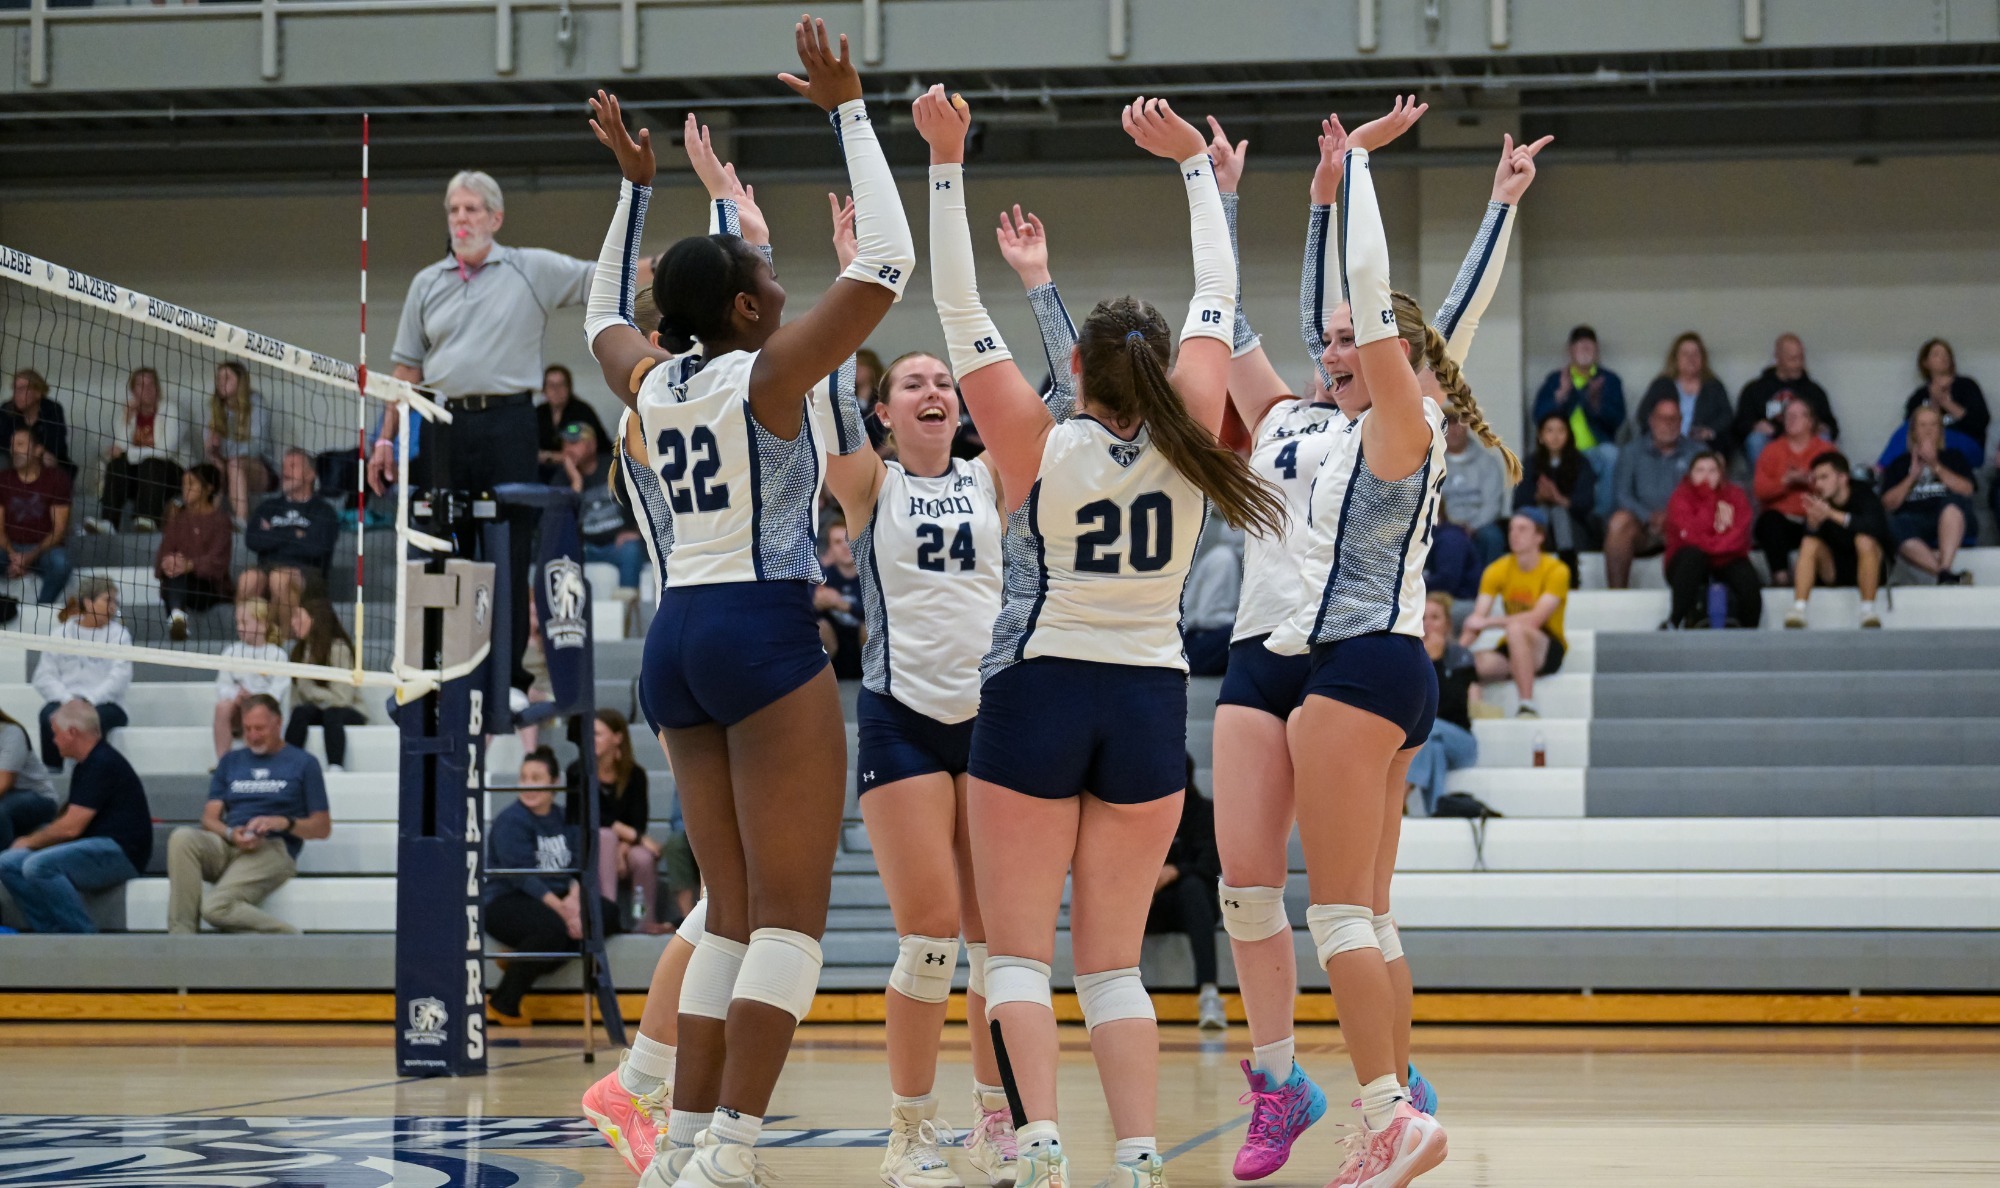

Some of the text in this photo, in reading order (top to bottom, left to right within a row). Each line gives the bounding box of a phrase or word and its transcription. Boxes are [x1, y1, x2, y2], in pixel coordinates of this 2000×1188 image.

[0, 247, 32, 276] LEGE
[67, 269, 117, 304] BLAZERS
[148, 298, 176, 323] HOOD
[176, 308, 218, 338] COLLEGE
[244, 332, 285, 360] BLAZERS
[656, 424, 731, 515] 22
[1274, 440, 1300, 480] 4
[909, 495, 974, 518] HOOD
[916, 521, 976, 572] 24
[1073, 490, 1173, 574] 20
[465, 689, 484, 1060] BLAZERS
